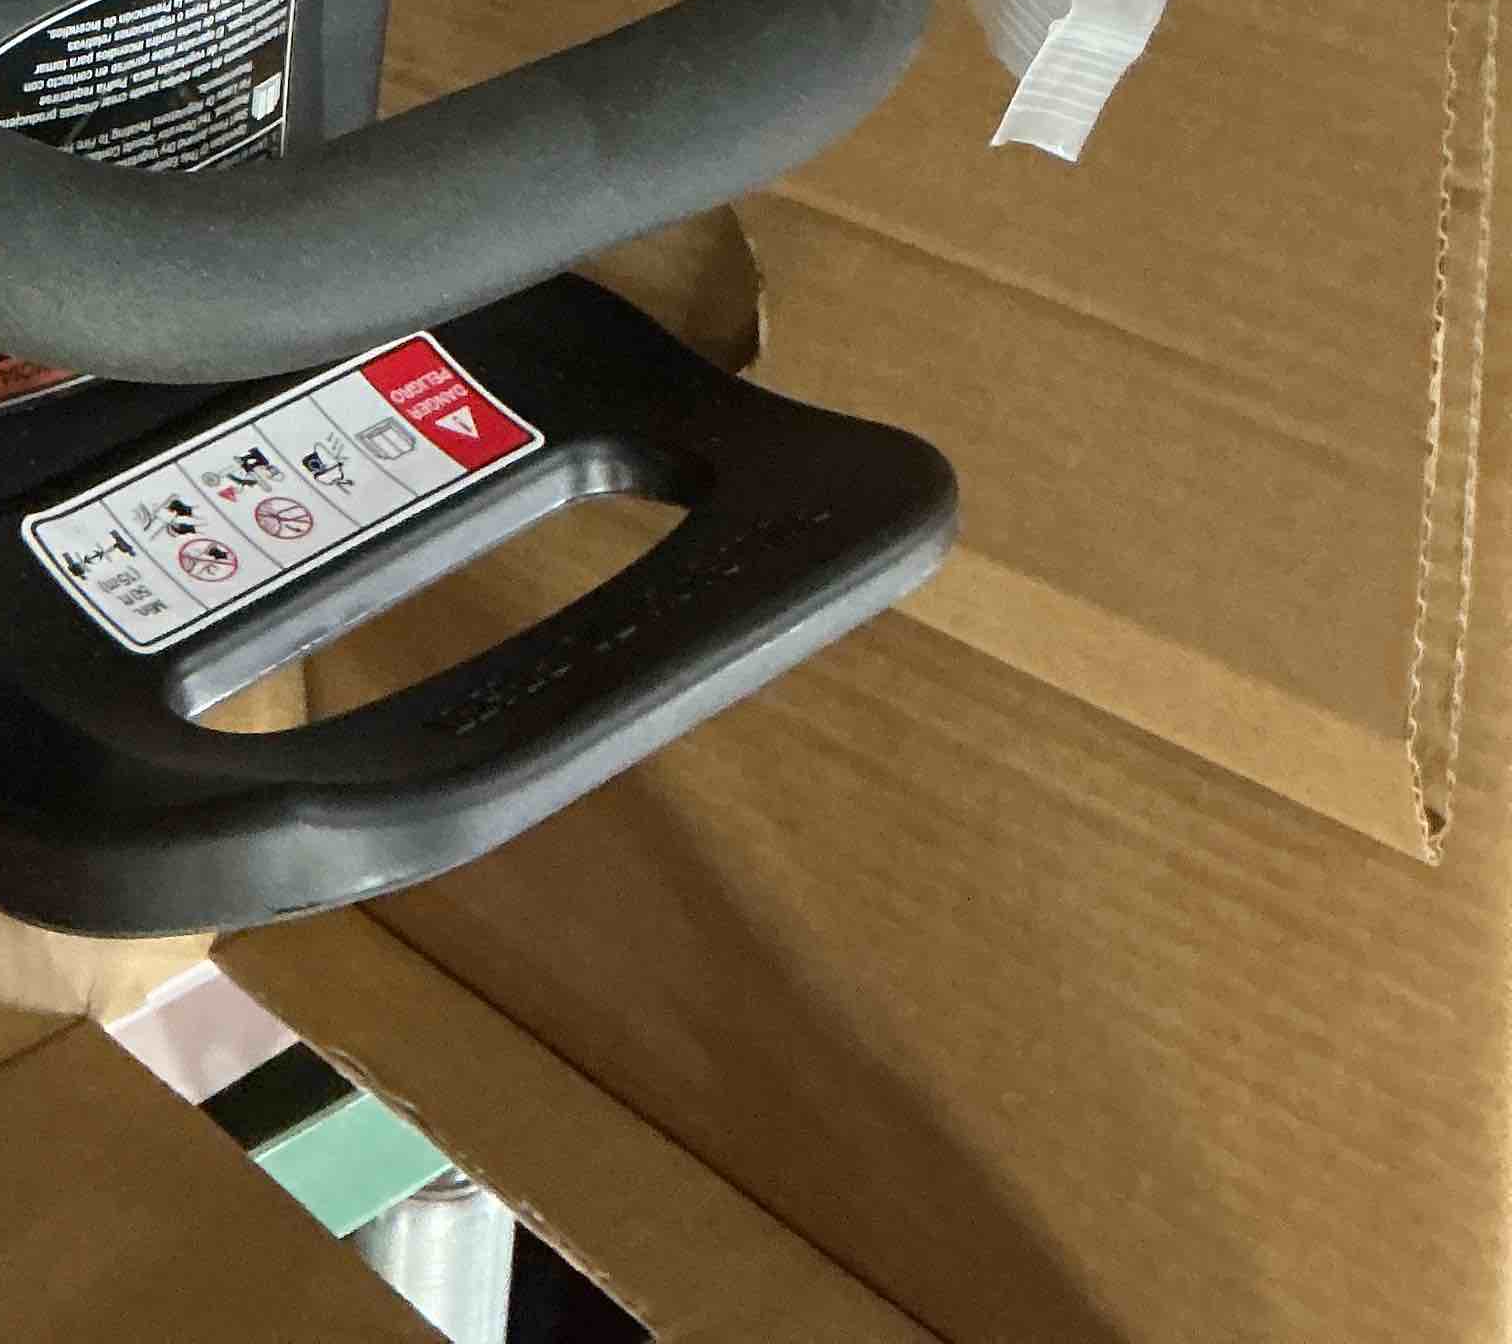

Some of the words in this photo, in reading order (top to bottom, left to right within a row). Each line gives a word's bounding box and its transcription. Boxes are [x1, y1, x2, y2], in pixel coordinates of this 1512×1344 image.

[102, 15, 117, 28] de
[69, 51, 94, 67] para
[34, 60, 67, 75] tomar
[94, 68, 109, 80] en
[23, 79, 44, 93] con
[46, 70, 93, 88] contacto
[97, 134, 110, 145] To
[389, 368, 454, 404] PELIGRO
[405, 383, 467, 421] DANGER
